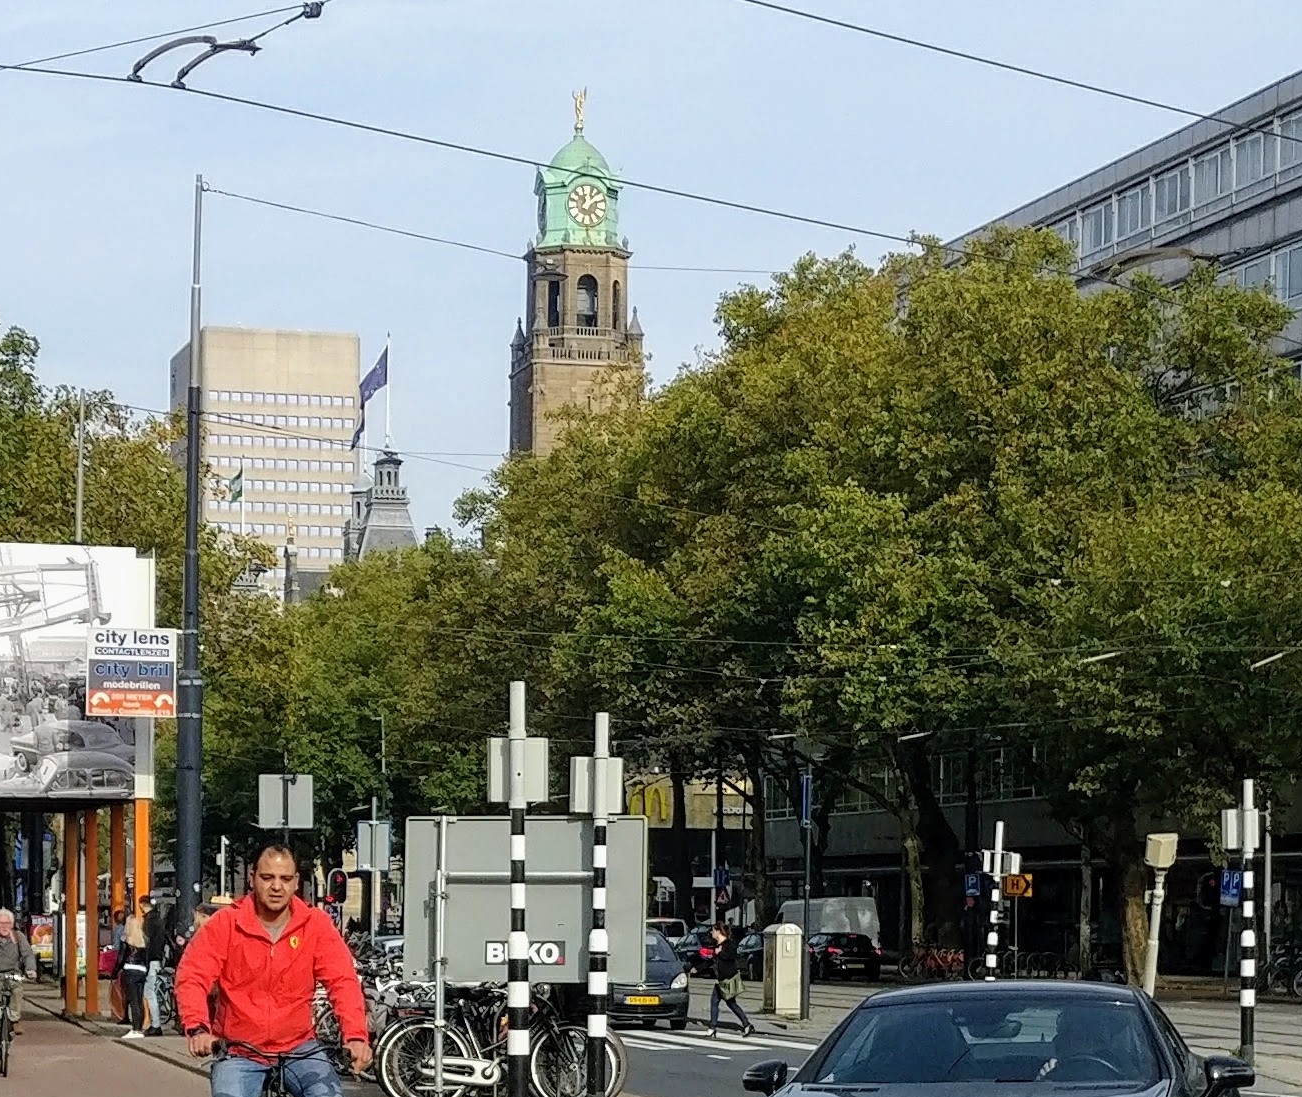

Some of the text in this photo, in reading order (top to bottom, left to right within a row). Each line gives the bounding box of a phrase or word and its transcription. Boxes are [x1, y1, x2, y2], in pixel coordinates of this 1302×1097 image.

[95, 630, 170, 646] city lens
[96, 647, 168, 657] CONTACTLENZEN
[94, 662, 169, 679] city bril
[103, 681, 161, 690] modebrillen
